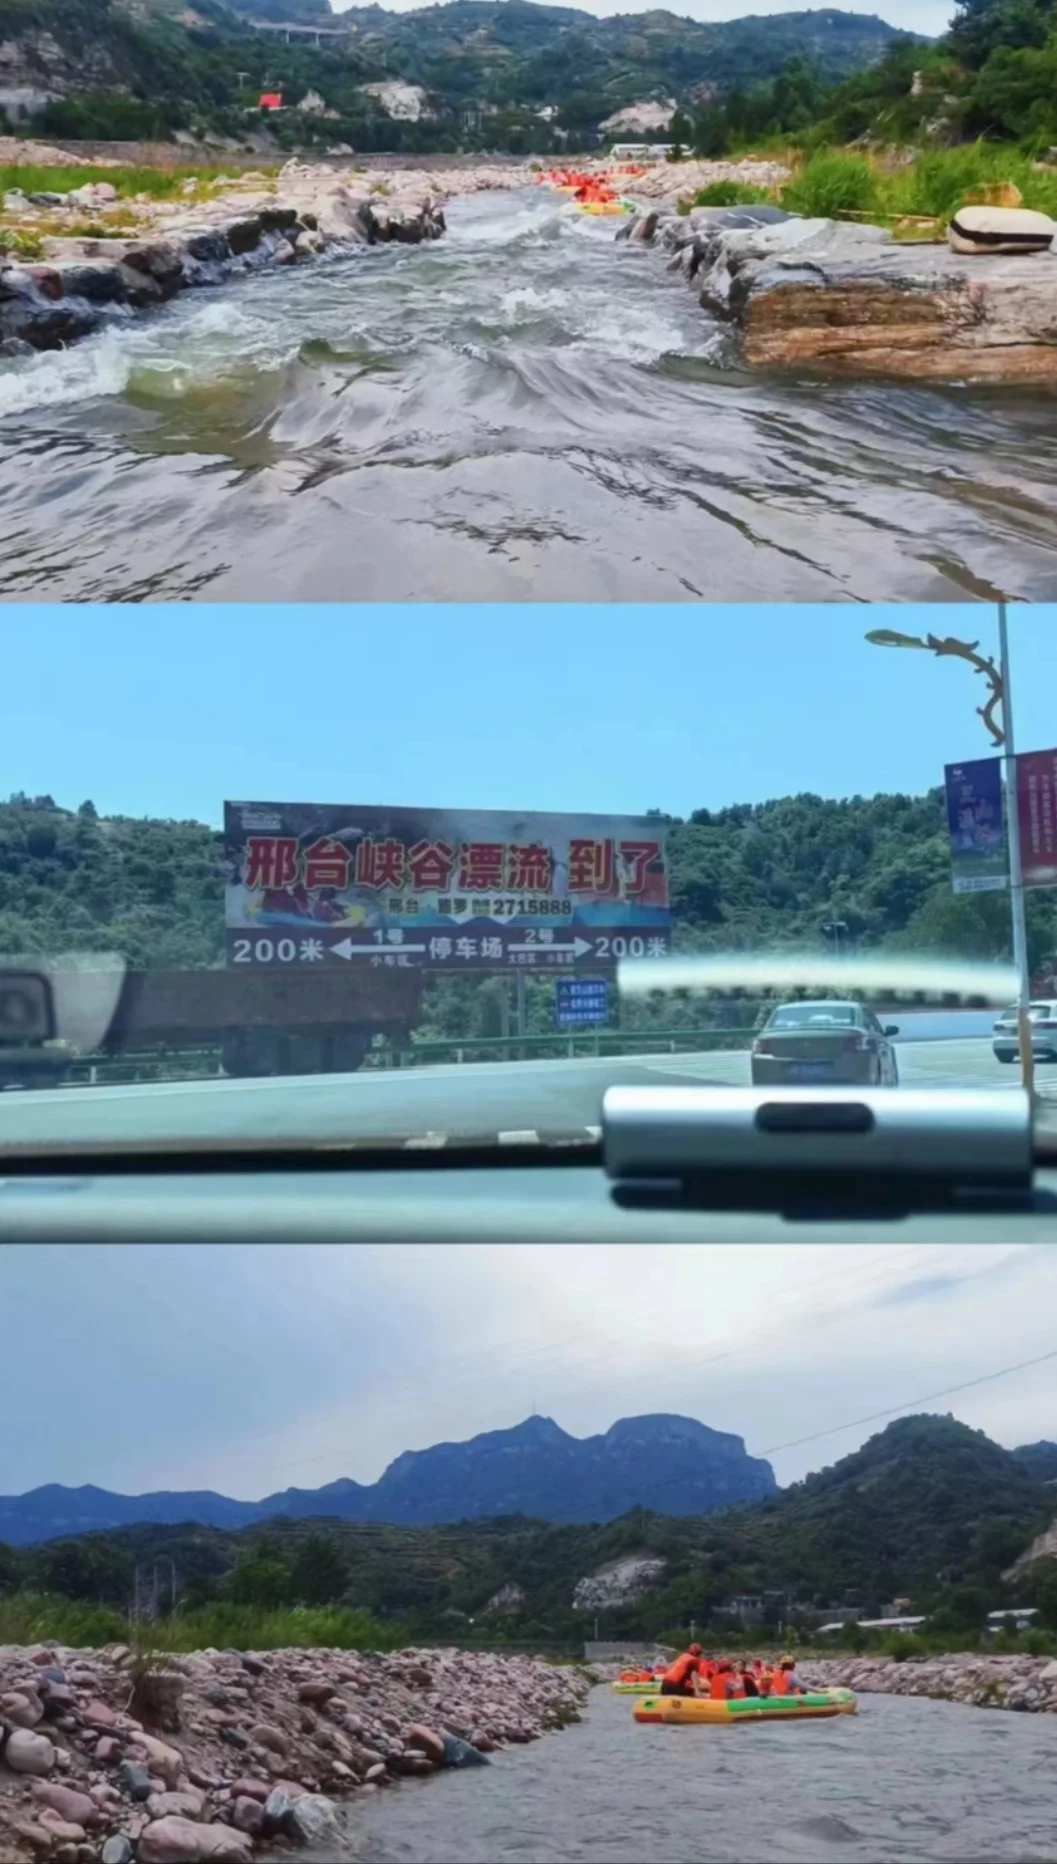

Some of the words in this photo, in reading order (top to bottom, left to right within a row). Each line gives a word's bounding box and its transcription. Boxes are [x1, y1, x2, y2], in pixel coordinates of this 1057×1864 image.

[244, 836, 553, 892] 邢台峡谷漂流
[567, 838, 661, 893] 到了
[493, 899, 571, 915] 2715888
[373, 928, 404, 944] 1号
[525, 928, 554, 944] 2号
[595, 936, 666, 958] 200米
[233, 937, 324, 962] 200米
[428, 936, 503, 960] 停车场
